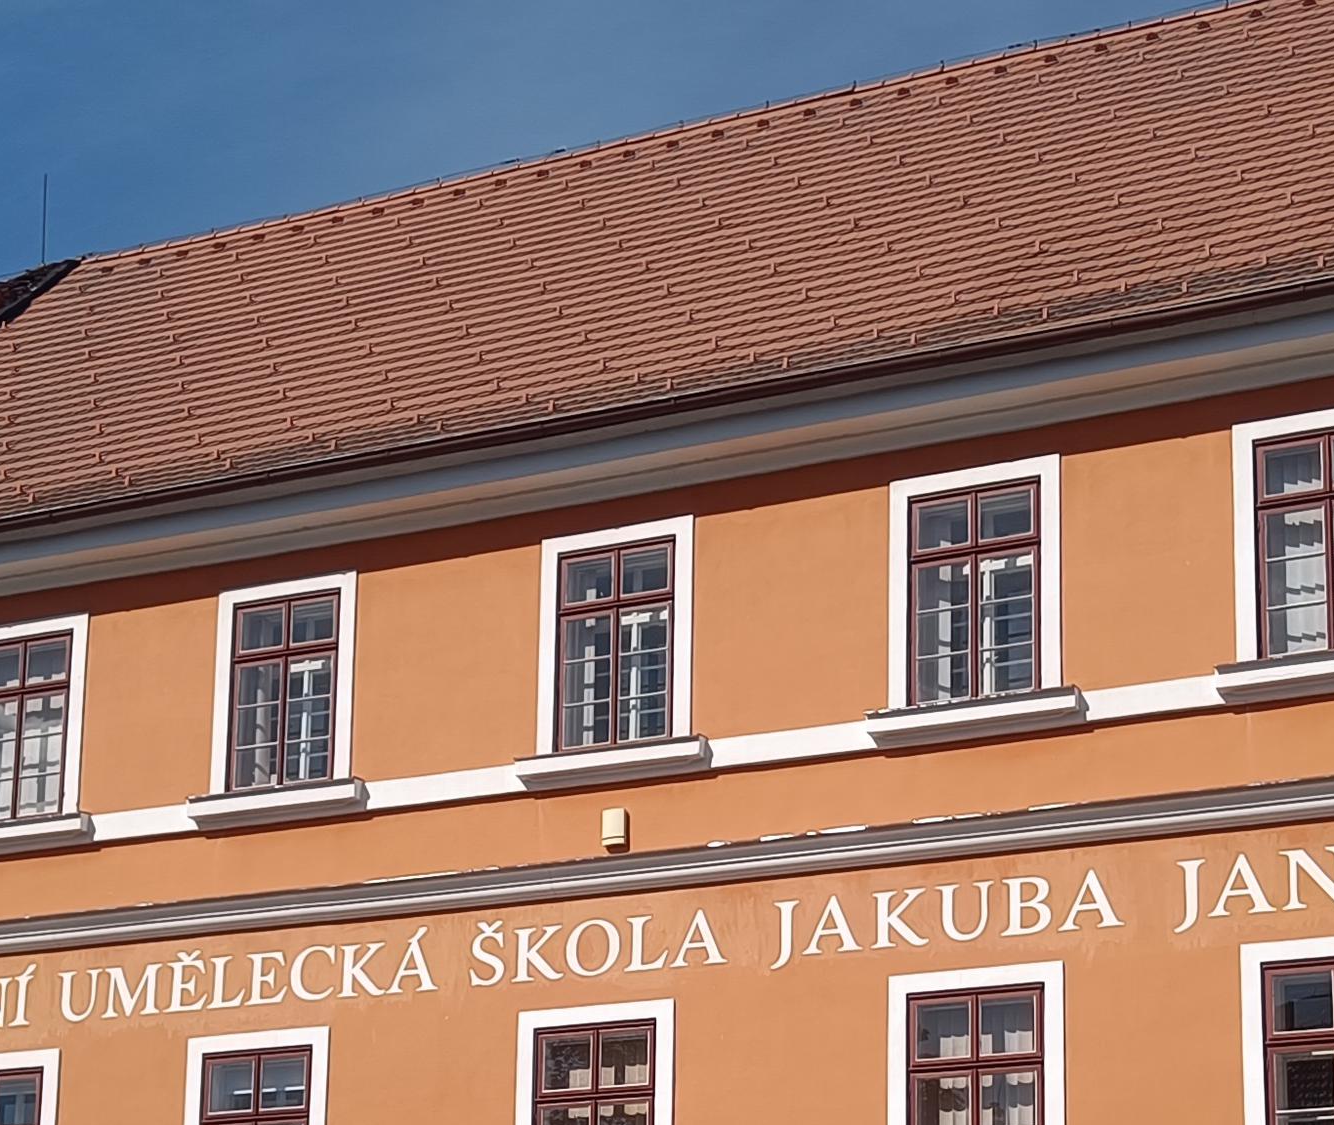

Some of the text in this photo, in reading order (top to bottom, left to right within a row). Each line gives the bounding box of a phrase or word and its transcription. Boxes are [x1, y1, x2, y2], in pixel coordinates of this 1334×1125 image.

[58, 926, 437, 1023] UMĚLECKÁ
[469, 909, 728, 986] ŠKOLA
[769, 868, 1124, 970] JAKUBA
